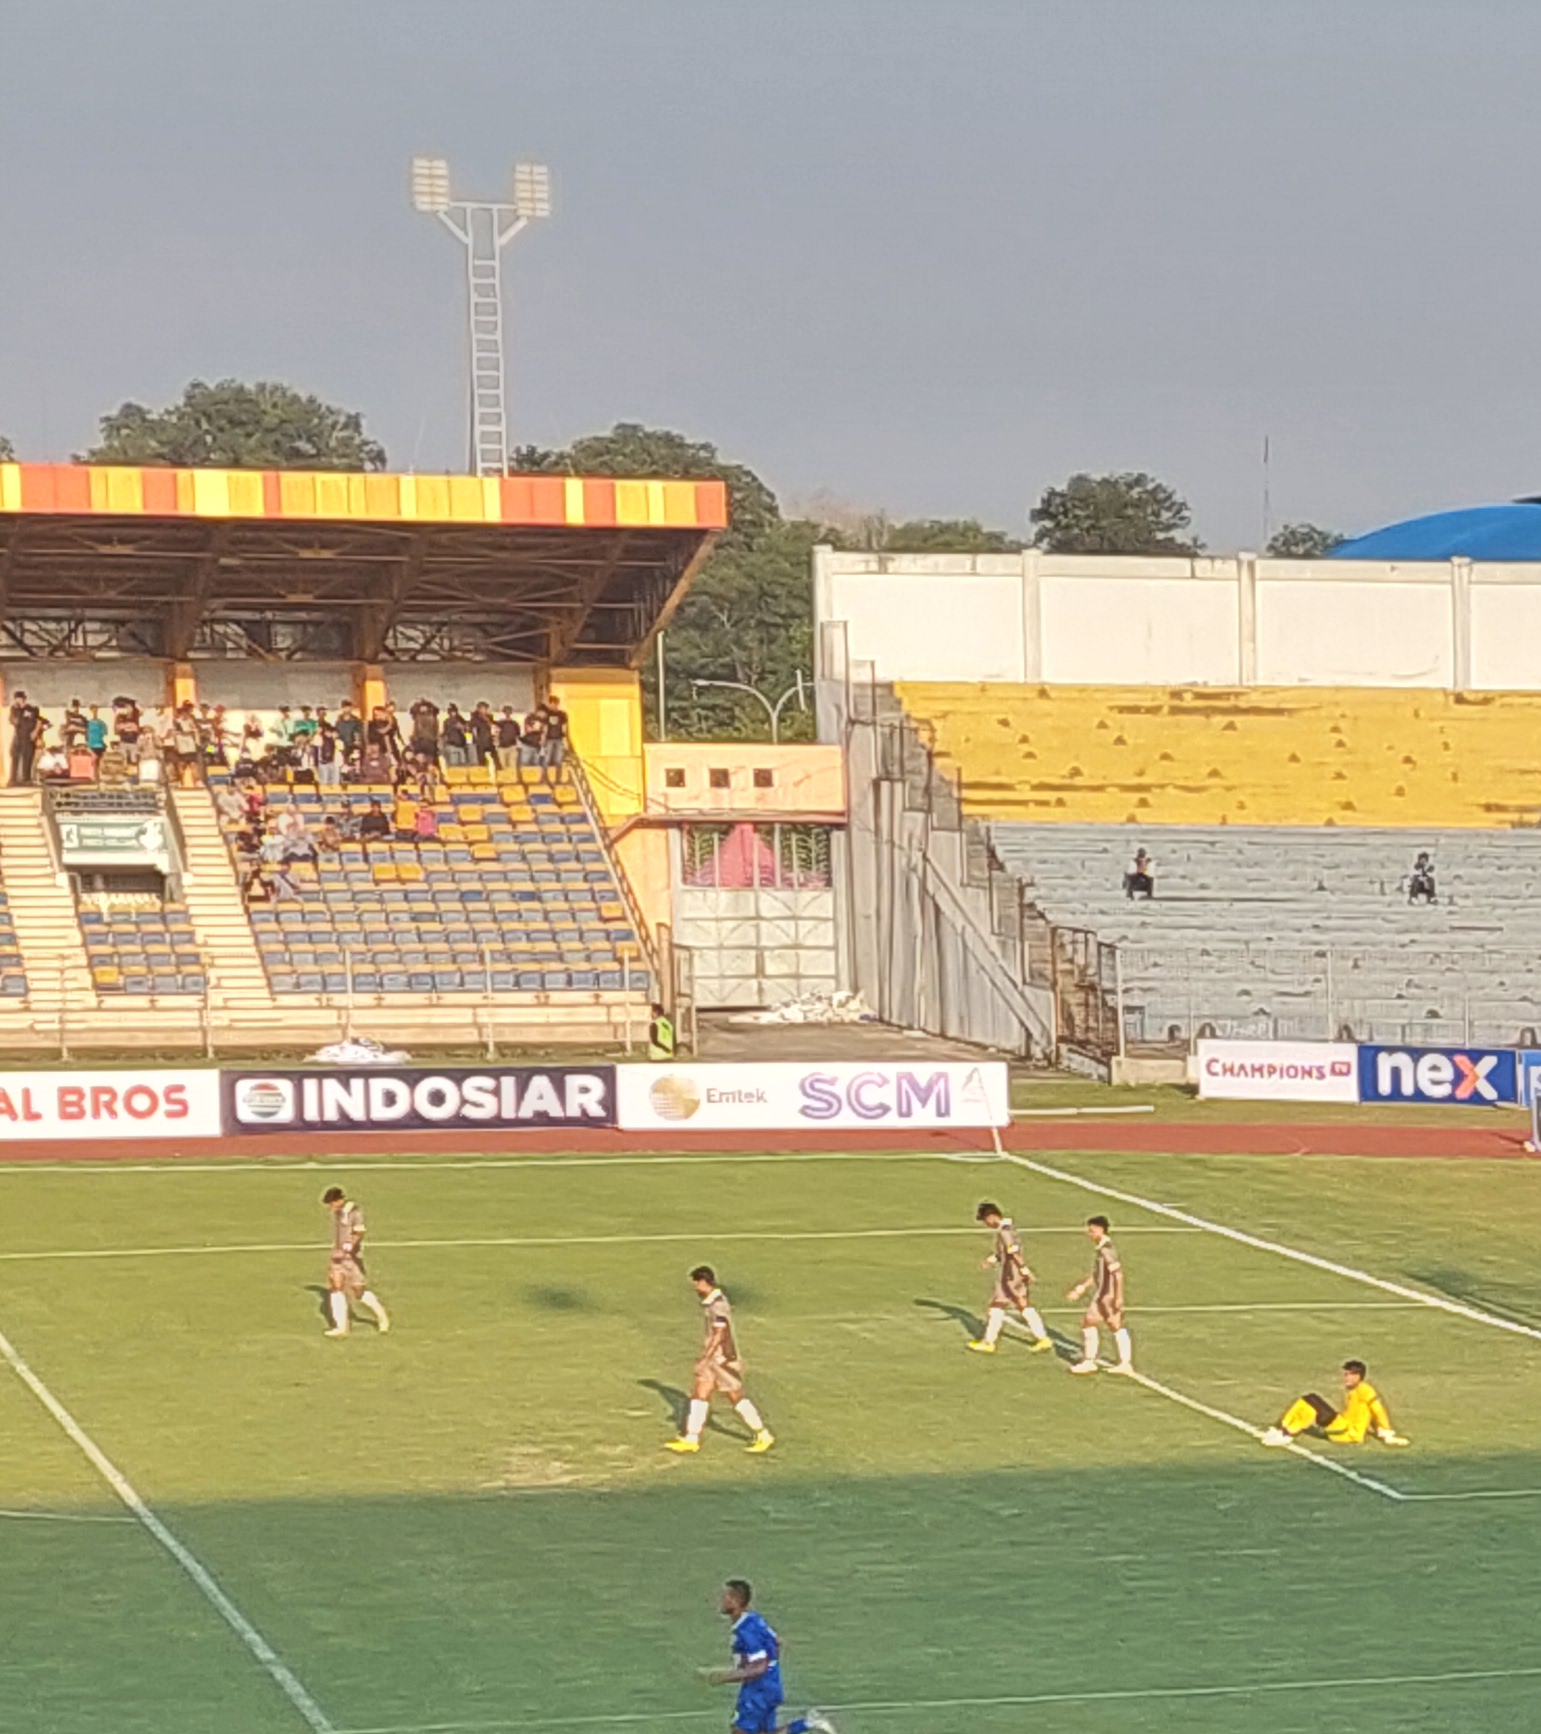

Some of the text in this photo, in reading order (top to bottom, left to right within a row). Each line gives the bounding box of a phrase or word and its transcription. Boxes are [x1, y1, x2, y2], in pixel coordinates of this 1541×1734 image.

[1205, 1057, 1326, 1080] CHAMPIONS
[1377, 1051, 1498, 1100] nex
[57, 1084, 189, 1120] BROS
[303, 1073, 607, 1123] INDOSIAR
[799, 1071, 950, 1120] SCM
